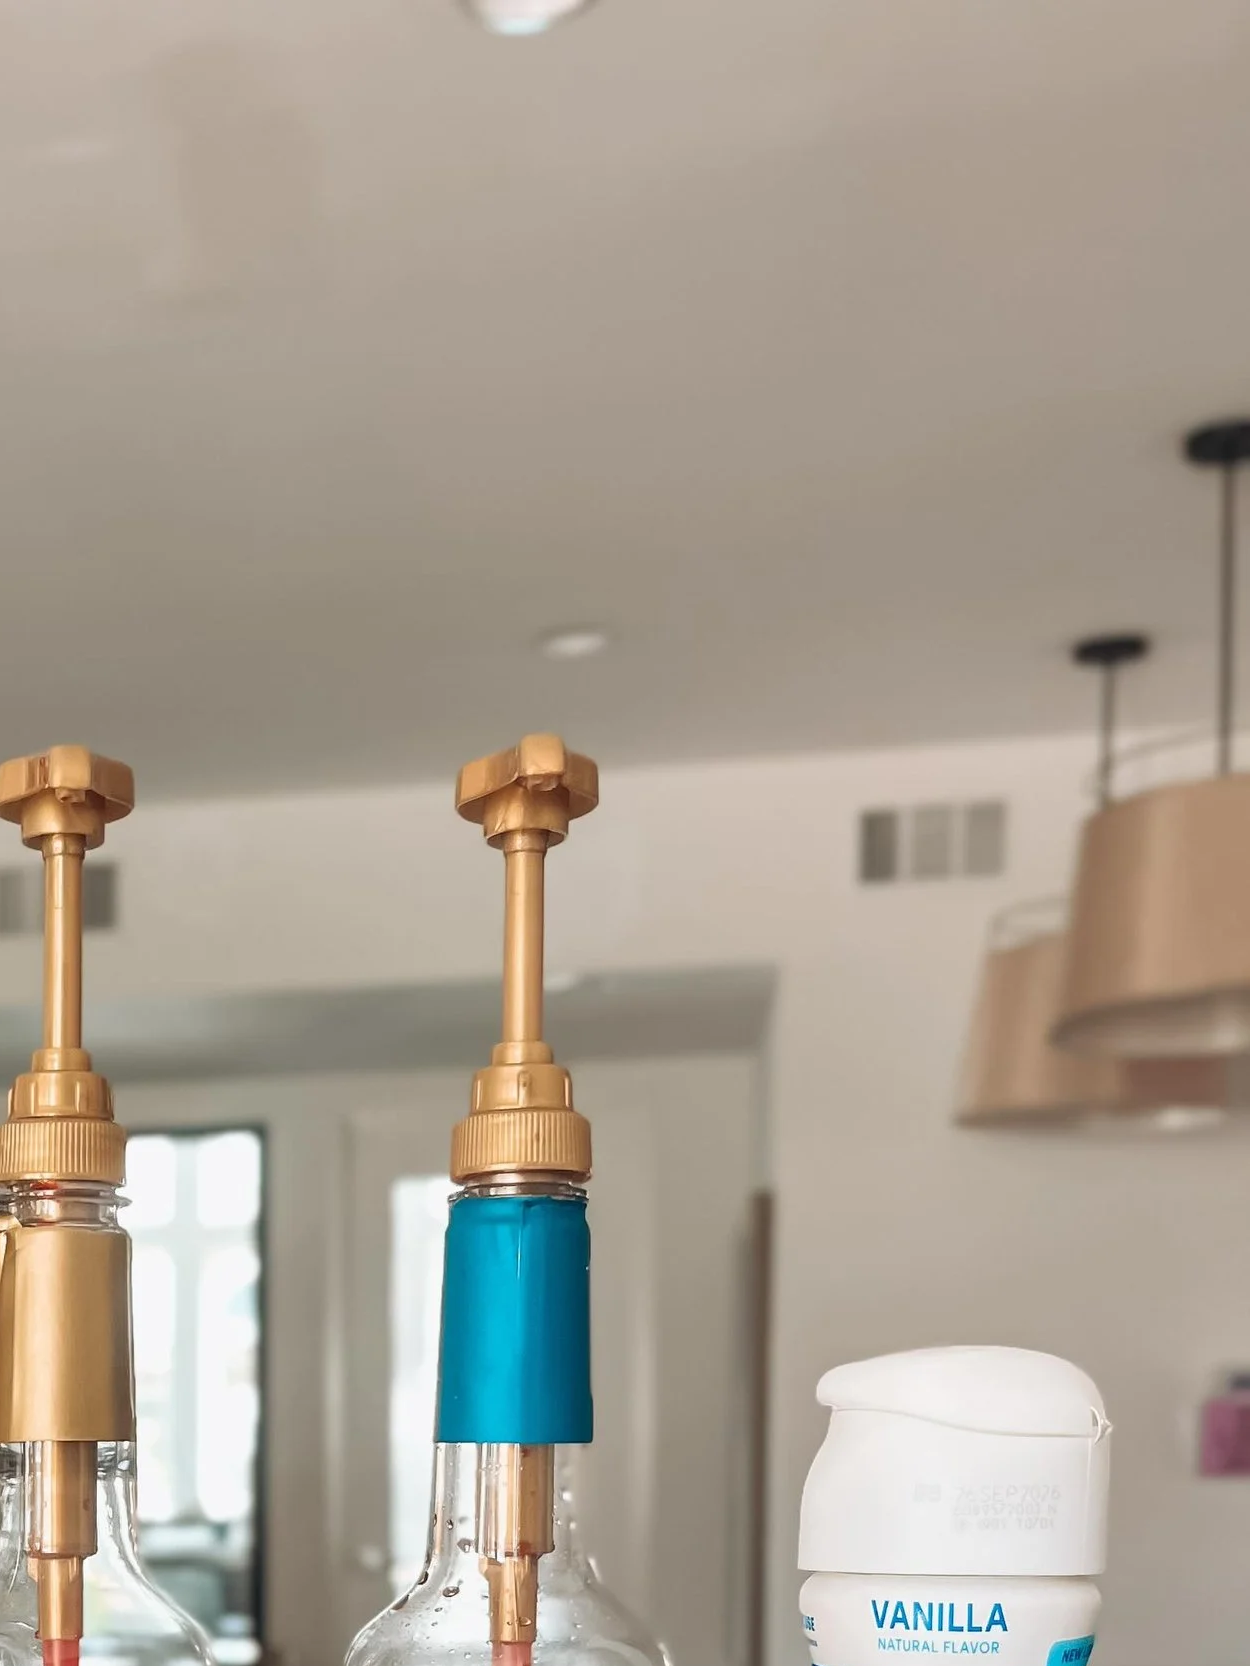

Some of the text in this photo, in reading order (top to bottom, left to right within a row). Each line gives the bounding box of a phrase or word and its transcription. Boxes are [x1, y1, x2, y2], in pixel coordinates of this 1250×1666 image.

[871, 1600, 1008, 1634] VANILLA
[877, 1638, 1000, 1655] NATURAL FLAVOR
